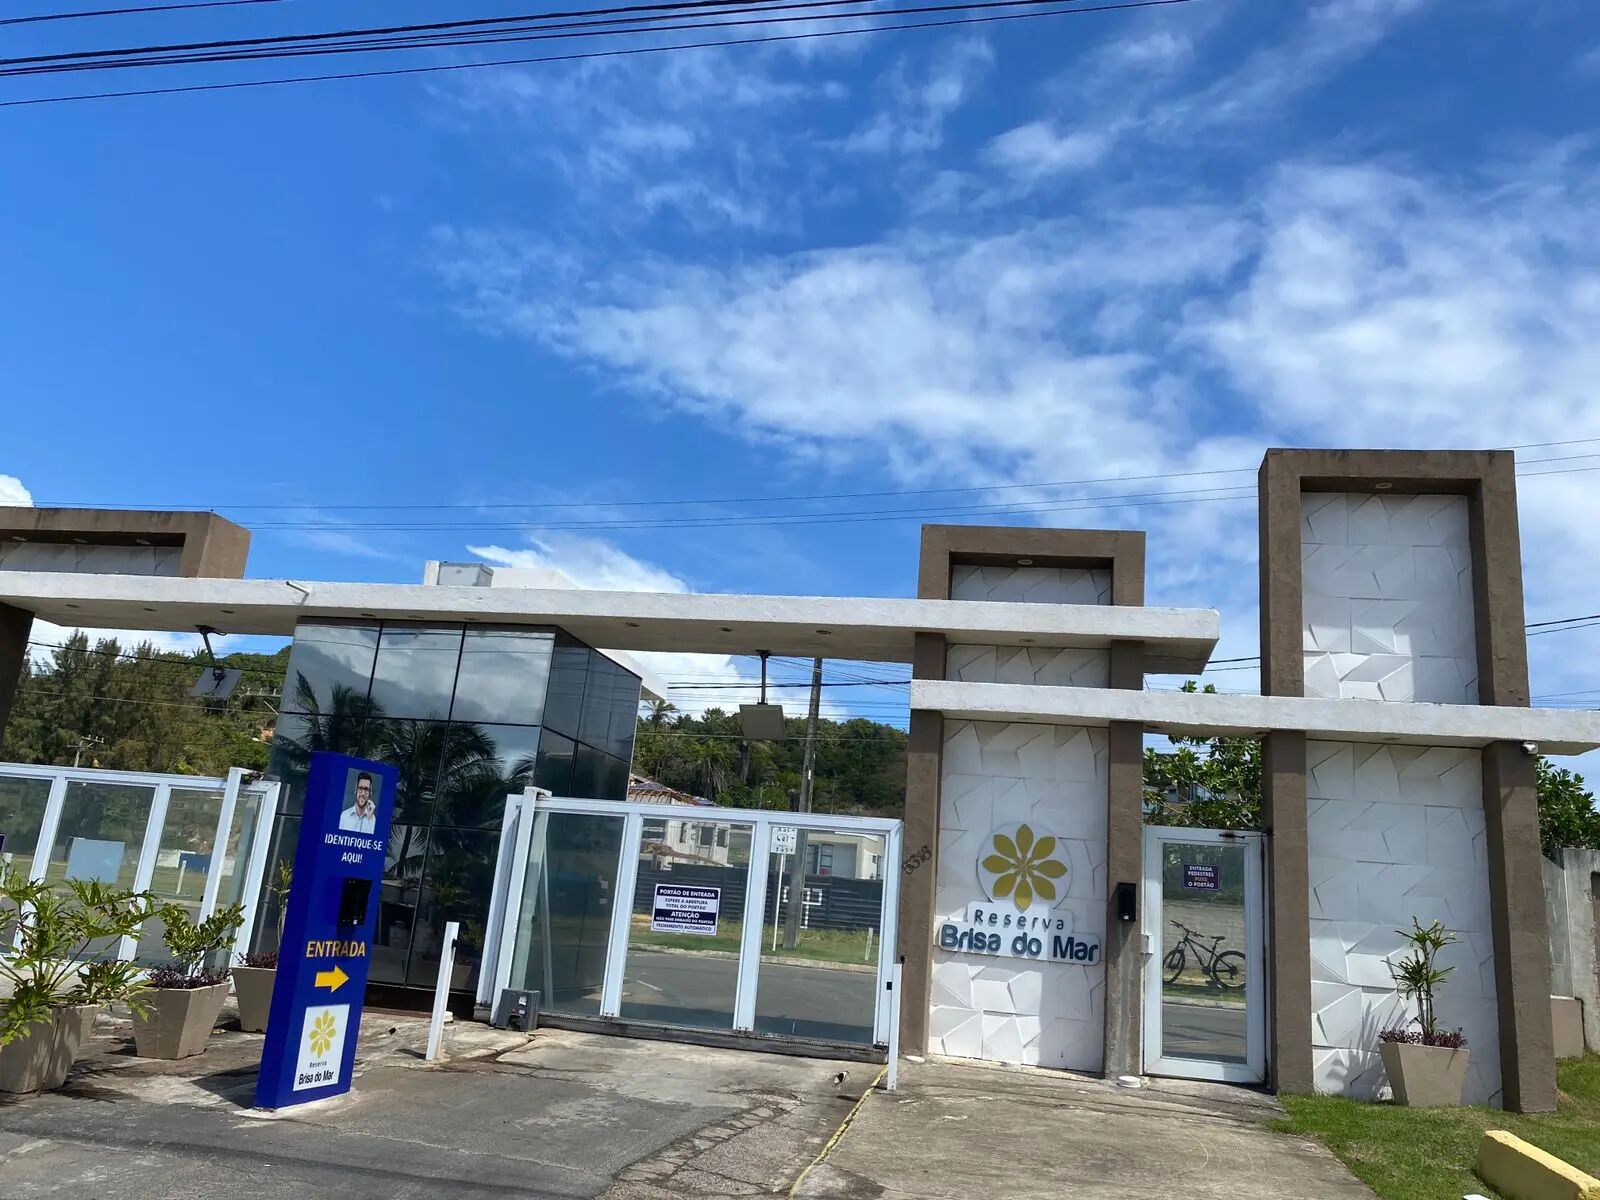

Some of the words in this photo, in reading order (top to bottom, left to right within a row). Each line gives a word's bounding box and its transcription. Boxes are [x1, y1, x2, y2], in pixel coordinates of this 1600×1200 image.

[324, 833, 383, 851] IDENTIFIQUE-SE
[341, 851, 363, 864] AQUI!
[975, 909, 1064, 930] Reserva
[306, 940, 366, 958] ENTRADA
[941, 924, 1002, 952] Brisa
[1011, 932, 1042, 957] do
[1053, 935, 1099, 962] Mar
[298, 1073, 314, 1085] Brisa
[314, 1071, 322, 1082] do
[323, 1070, 334, 1081] Mar
